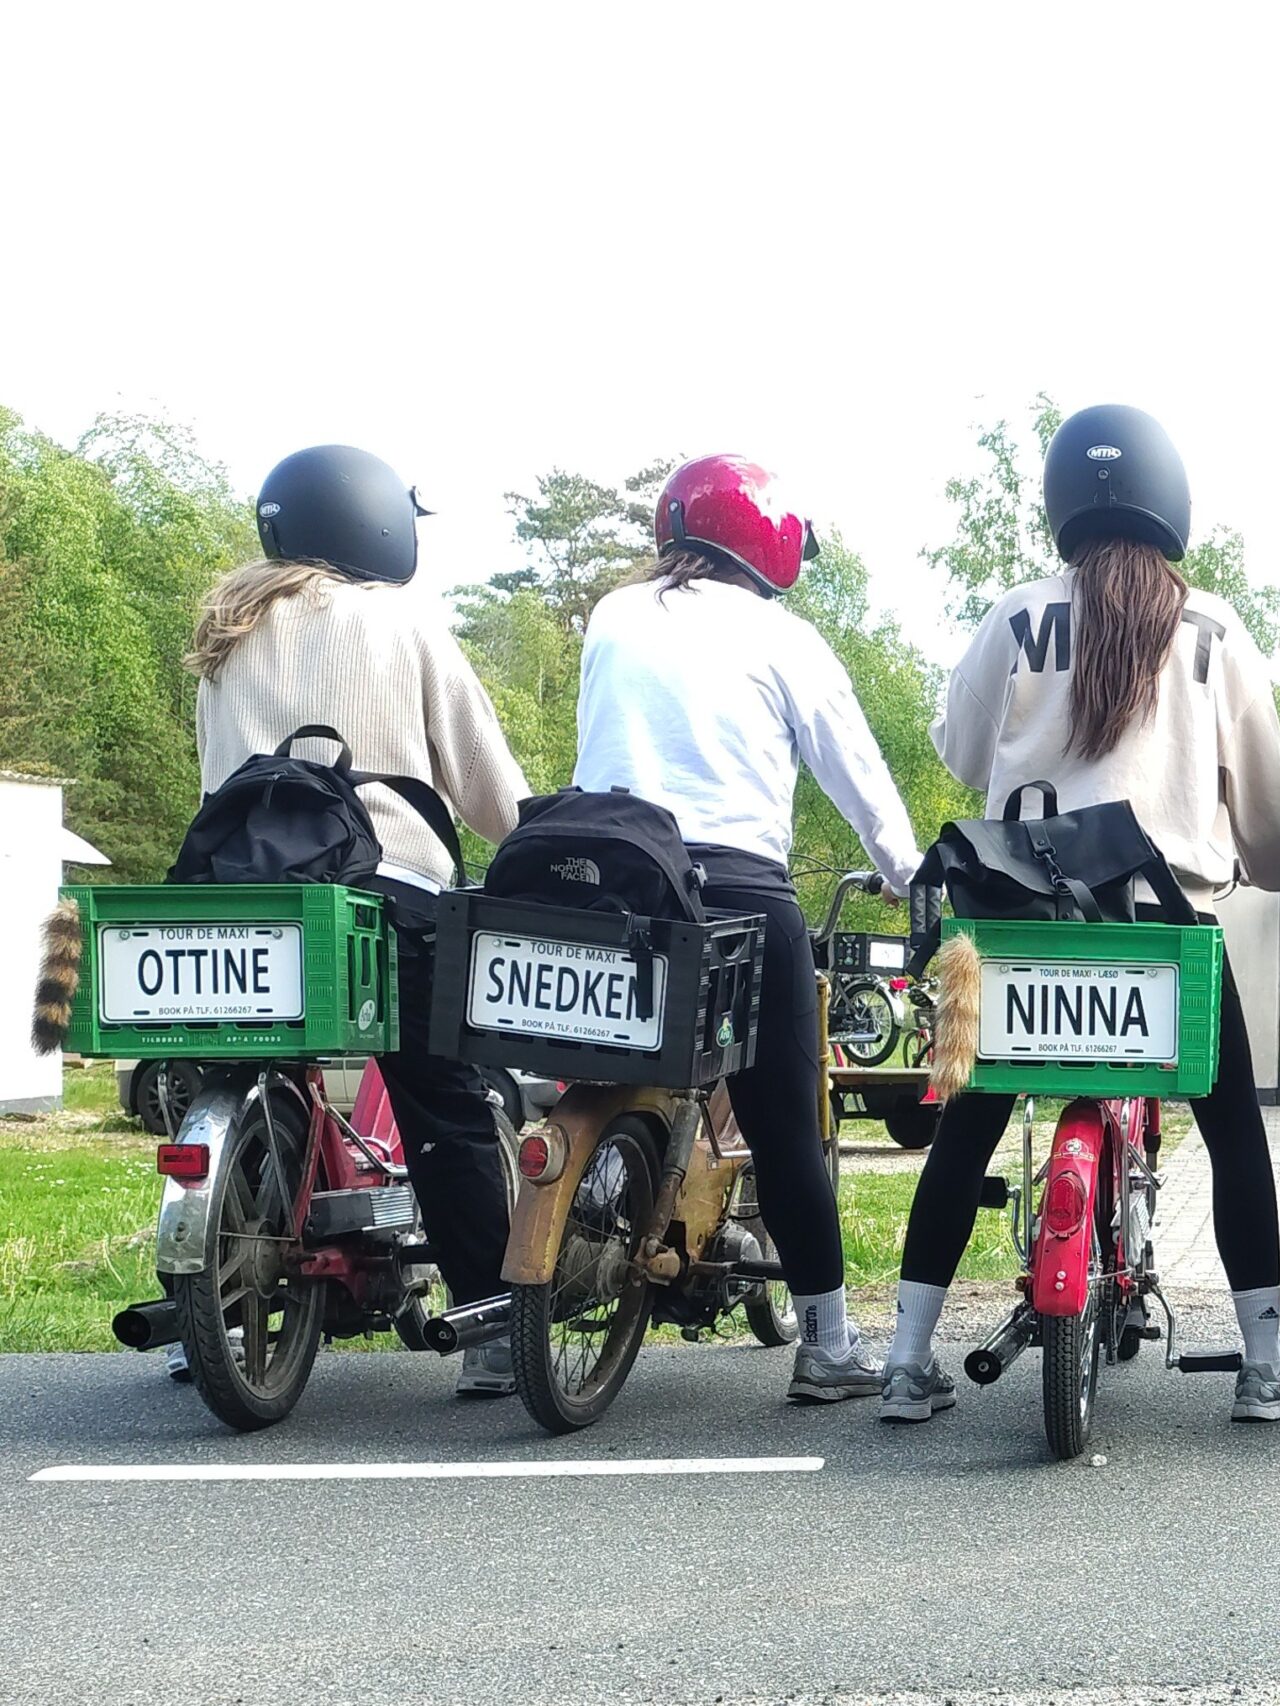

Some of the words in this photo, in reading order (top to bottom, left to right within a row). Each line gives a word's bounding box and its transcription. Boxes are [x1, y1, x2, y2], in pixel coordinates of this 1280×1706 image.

[565, 857, 586, 866] THE
[550, 864, 586, 874] NORTH
[561, 872, 586, 882] FACE
[159, 928, 194, 940] TOUR
[197, 928, 214, 939] DE
[217, 927, 249, 939] MAXI
[530, 941, 564, 958] TOUR
[566, 946, 583, 959] DE
[585, 949, 616, 964] MAXI
[138, 948, 270, 996] OTTINE
[1039, 968, 1058, 978] TOUR
[1060, 968, 1071, 978] DE
[1072, 969, 1092, 978] MAXI
[1098, 970, 1119, 979] LÆSØ
[158, 1006, 182, 1016] BOOK
[183, 1005, 194, 1015] PÅ
[196, 1006, 213, 1015] TLF.
[213, 1005, 252, 1015] 61266267
[1006, 983, 1149, 1037] NINNA
[521, 1018, 544, 1029] BOOK
[545, 1019, 556, 1030] PÅ
[573, 1026, 610, 1038] 61266267
[1038, 1043, 1058, 1052] BOOK
[1059, 1042, 1070, 1052] PÅ
[1085, 1044, 1117, 1053] 61266267
